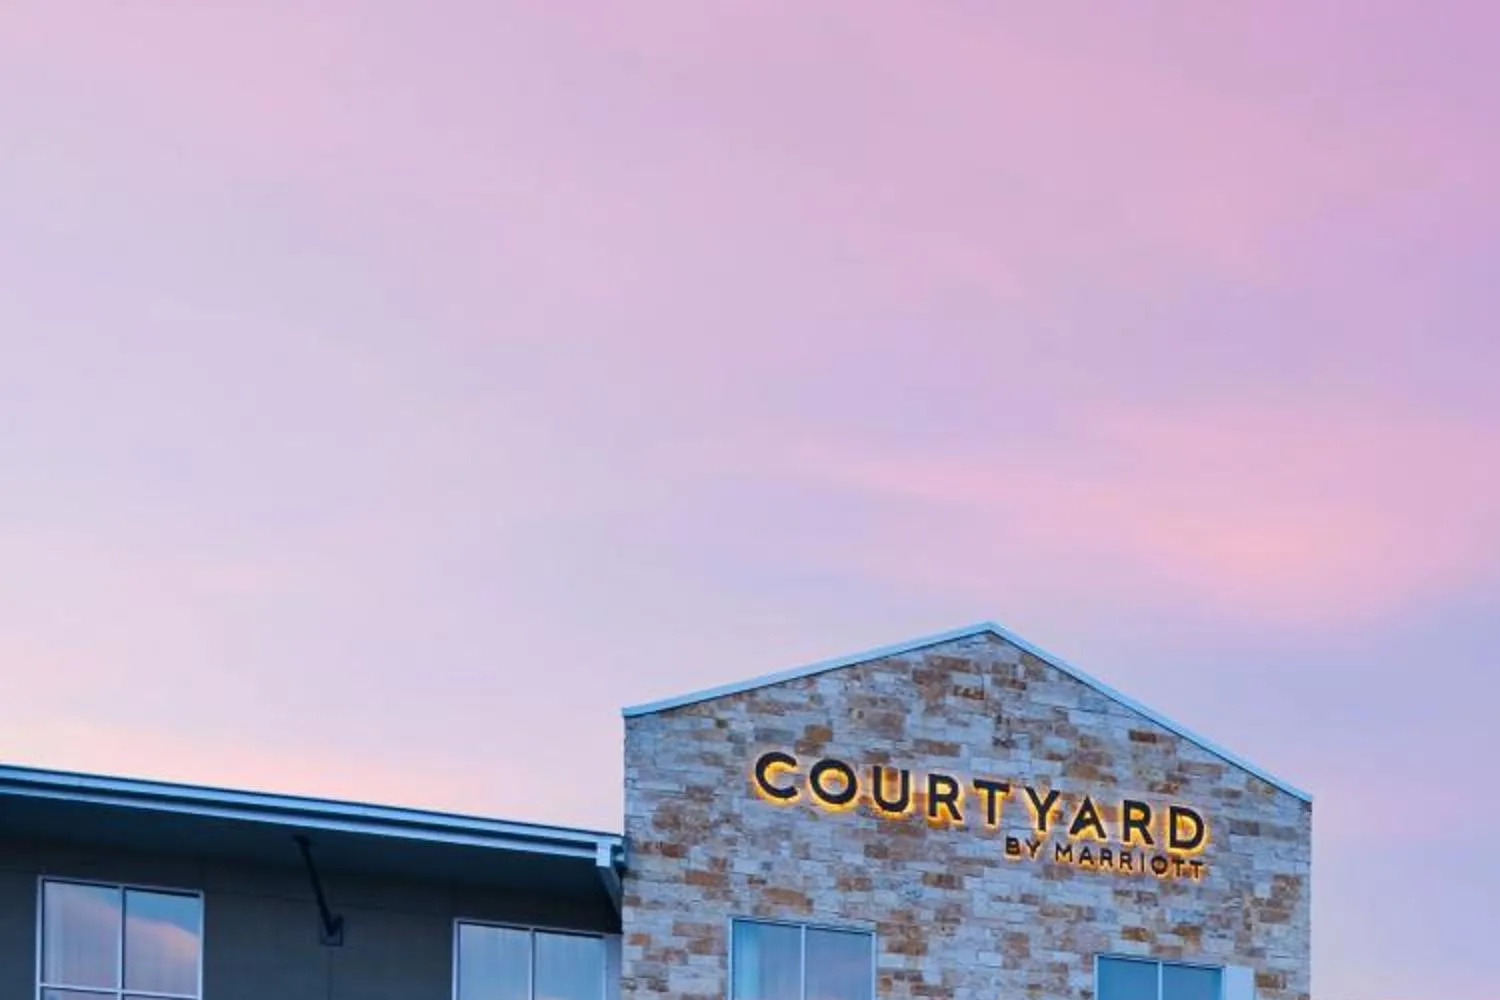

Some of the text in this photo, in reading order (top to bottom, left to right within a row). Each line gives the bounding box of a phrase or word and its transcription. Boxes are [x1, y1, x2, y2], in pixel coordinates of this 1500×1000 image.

[755, 751, 1206, 850] COURTYARD
[1005, 836, 1204, 878] BY MARRIOTT
